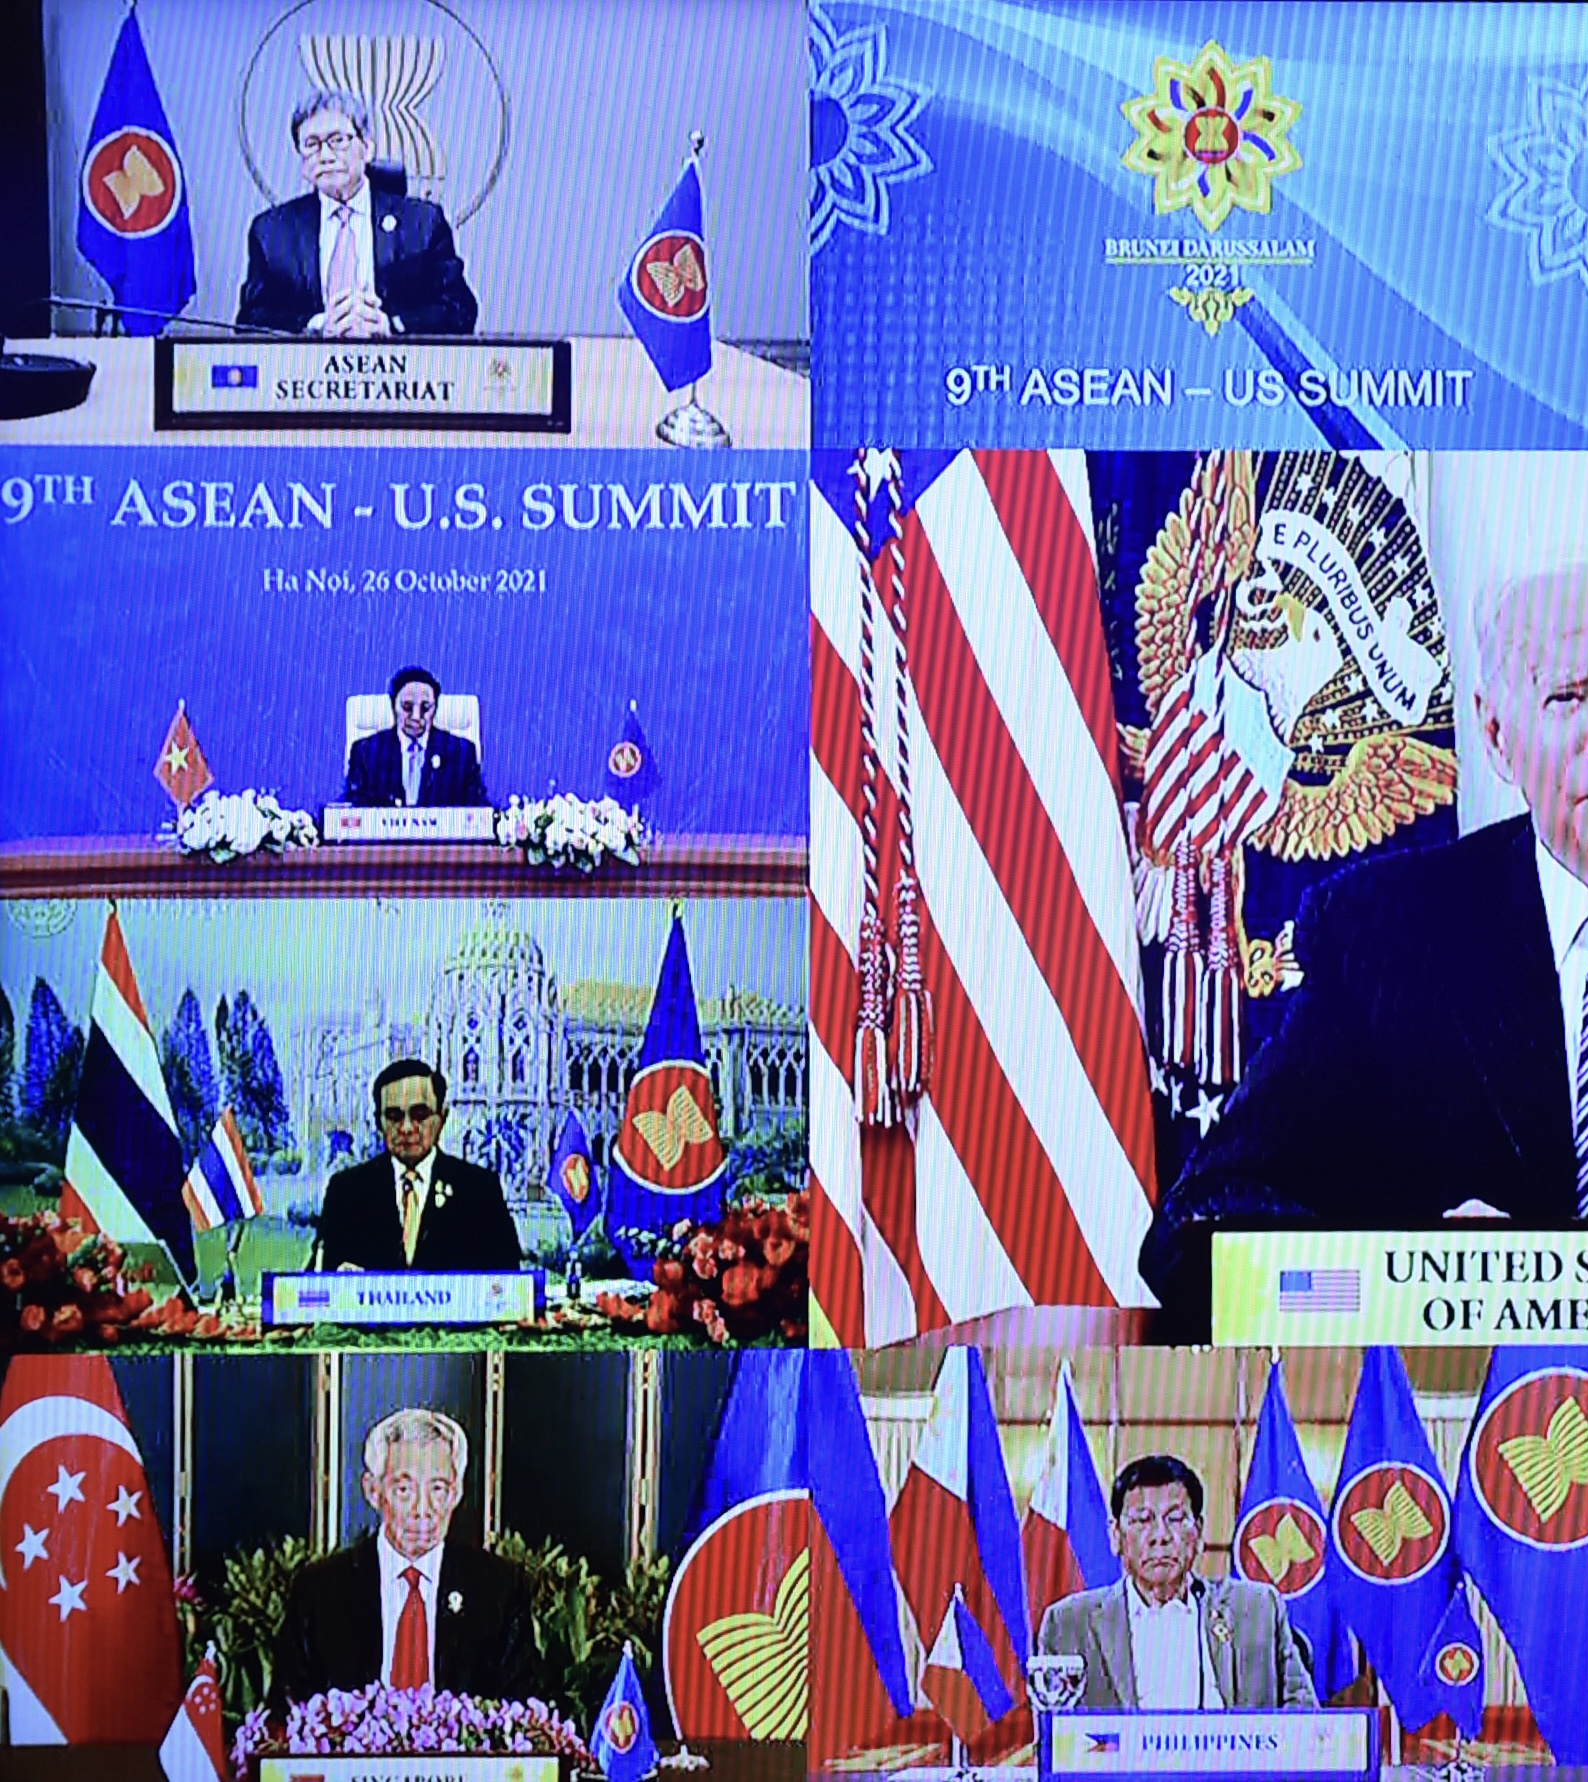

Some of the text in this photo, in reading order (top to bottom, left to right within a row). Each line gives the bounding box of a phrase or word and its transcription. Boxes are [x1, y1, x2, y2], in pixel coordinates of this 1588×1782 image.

[1104, 238, 1315, 257] BRUNEI DARUSSALAM
[1185, 264, 1240, 287] 2021
[323, 354, 408, 375] ASEAN
[275, 379, 456, 401] SECRETARIAT
[945, 364, 1012, 406] 9TH
[1020, 368, 1172, 406] ASEAN
[1224, 368, 1286, 406] US
[1298, 368, 1473, 406] SUMMIT
[1, 473, 95, 525] 9TH
[109, 479, 337, 529] ASEAN
[390, 481, 504, 530] U.S.
[522, 480, 798, 530] SUMMIT
[262, 568, 299, 592] Ha
[362, 569, 390, 592] 26
[395, 569, 492, 592] October
[497, 568, 548, 593] 2021
[1273, 523, 1417, 711] E PLURIBUS UNUM
[1386, 1249, 1562, 1283] UNITED
[356, 1290, 452, 1306] THAILAND
[1422, 1297, 1485, 1331] OF
[1142, 1733, 1279, 1751] PHILIPPINES
